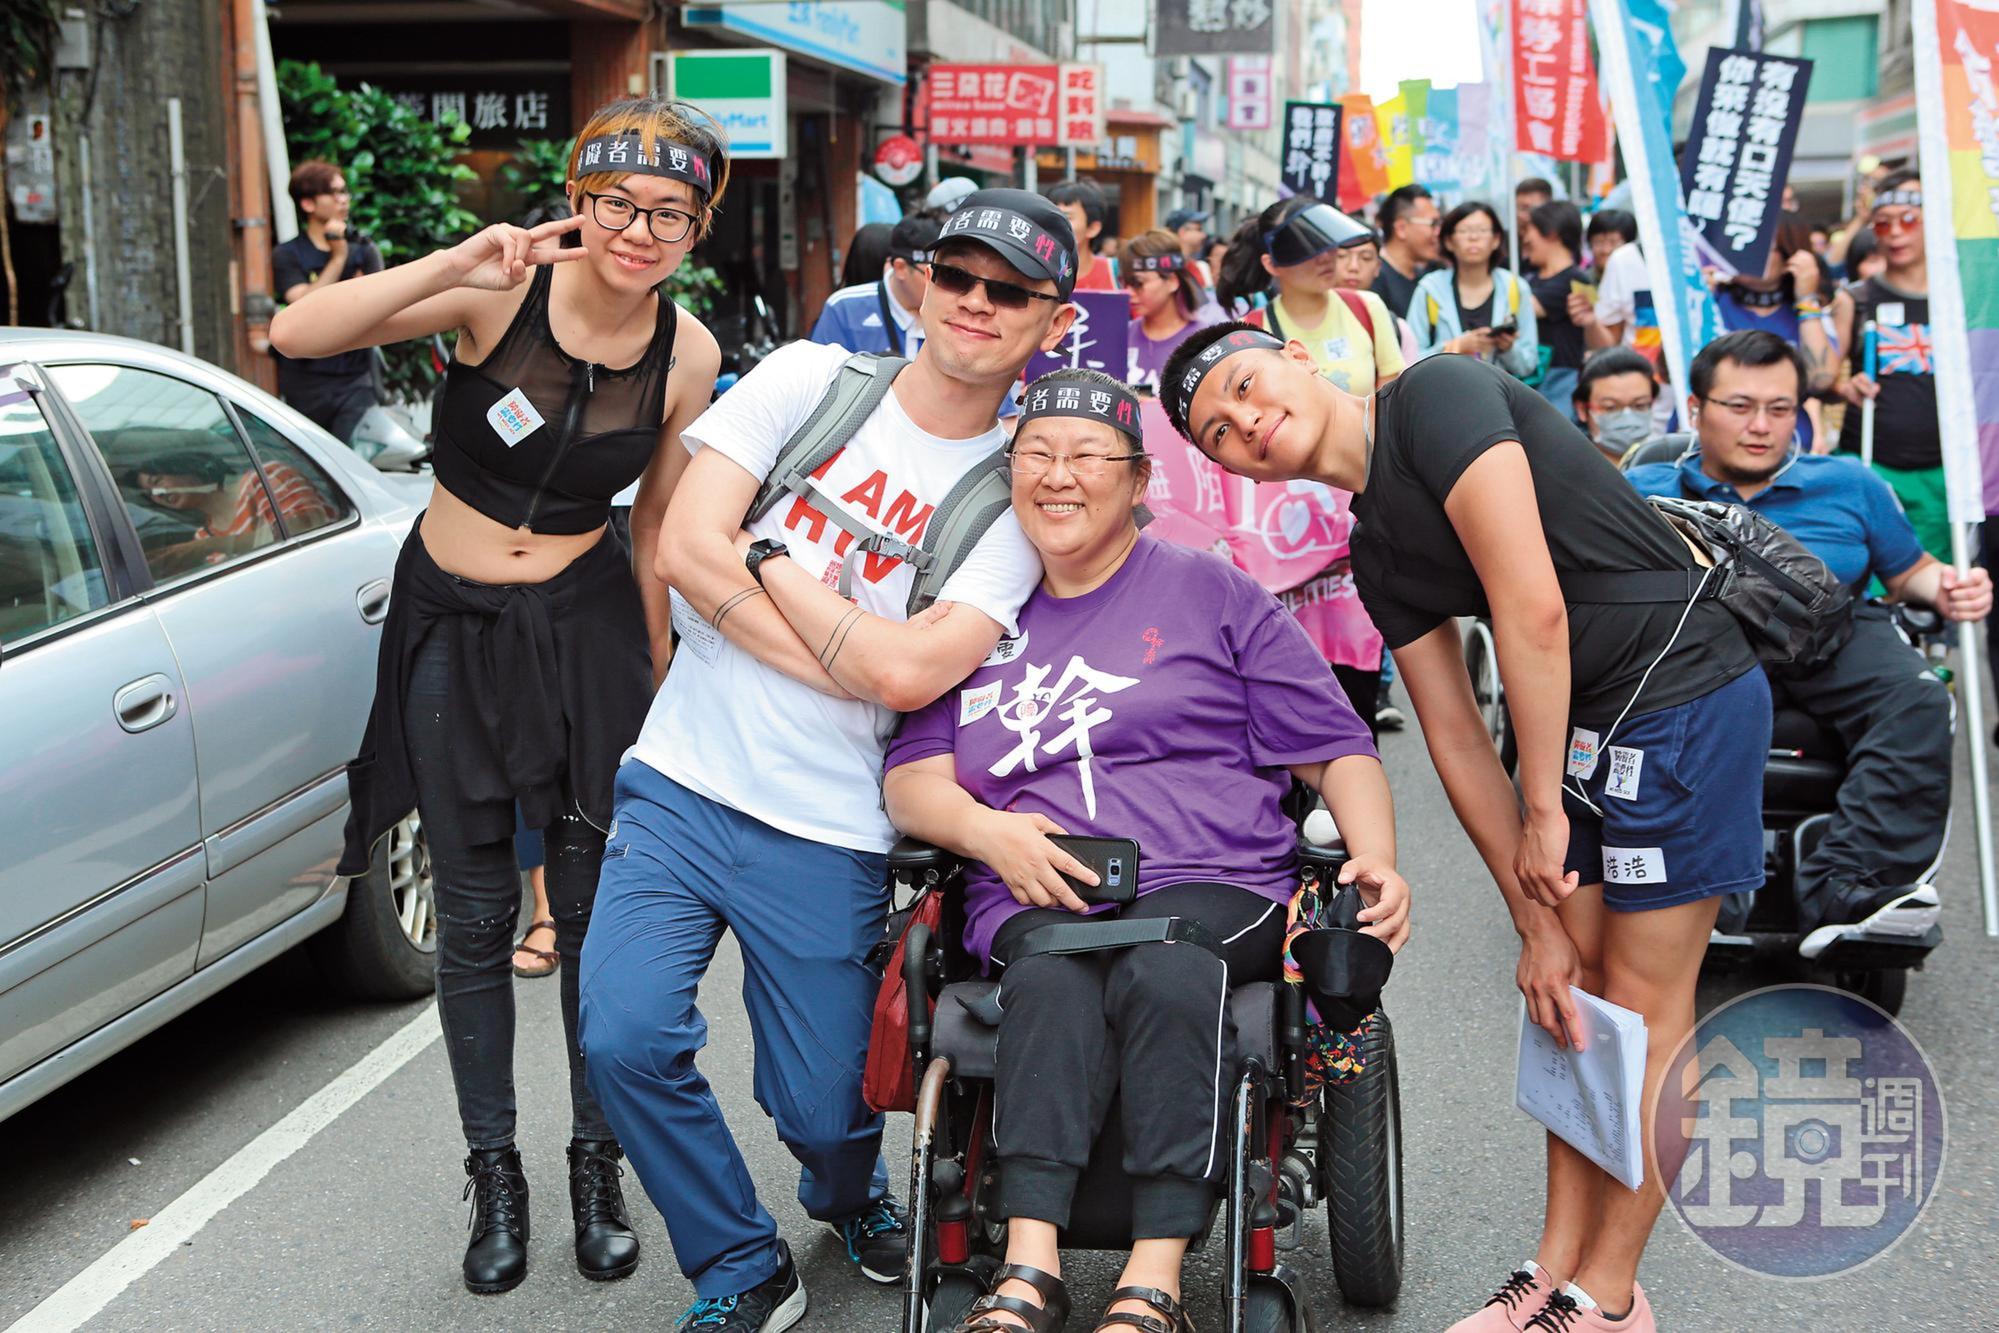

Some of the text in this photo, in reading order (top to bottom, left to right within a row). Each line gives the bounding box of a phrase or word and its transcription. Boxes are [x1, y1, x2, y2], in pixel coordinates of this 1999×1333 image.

[1020, 387, 1132, 426] 者需要性
[784, 495, 905, 584] HIV
[840, 469, 935, 544] AM
